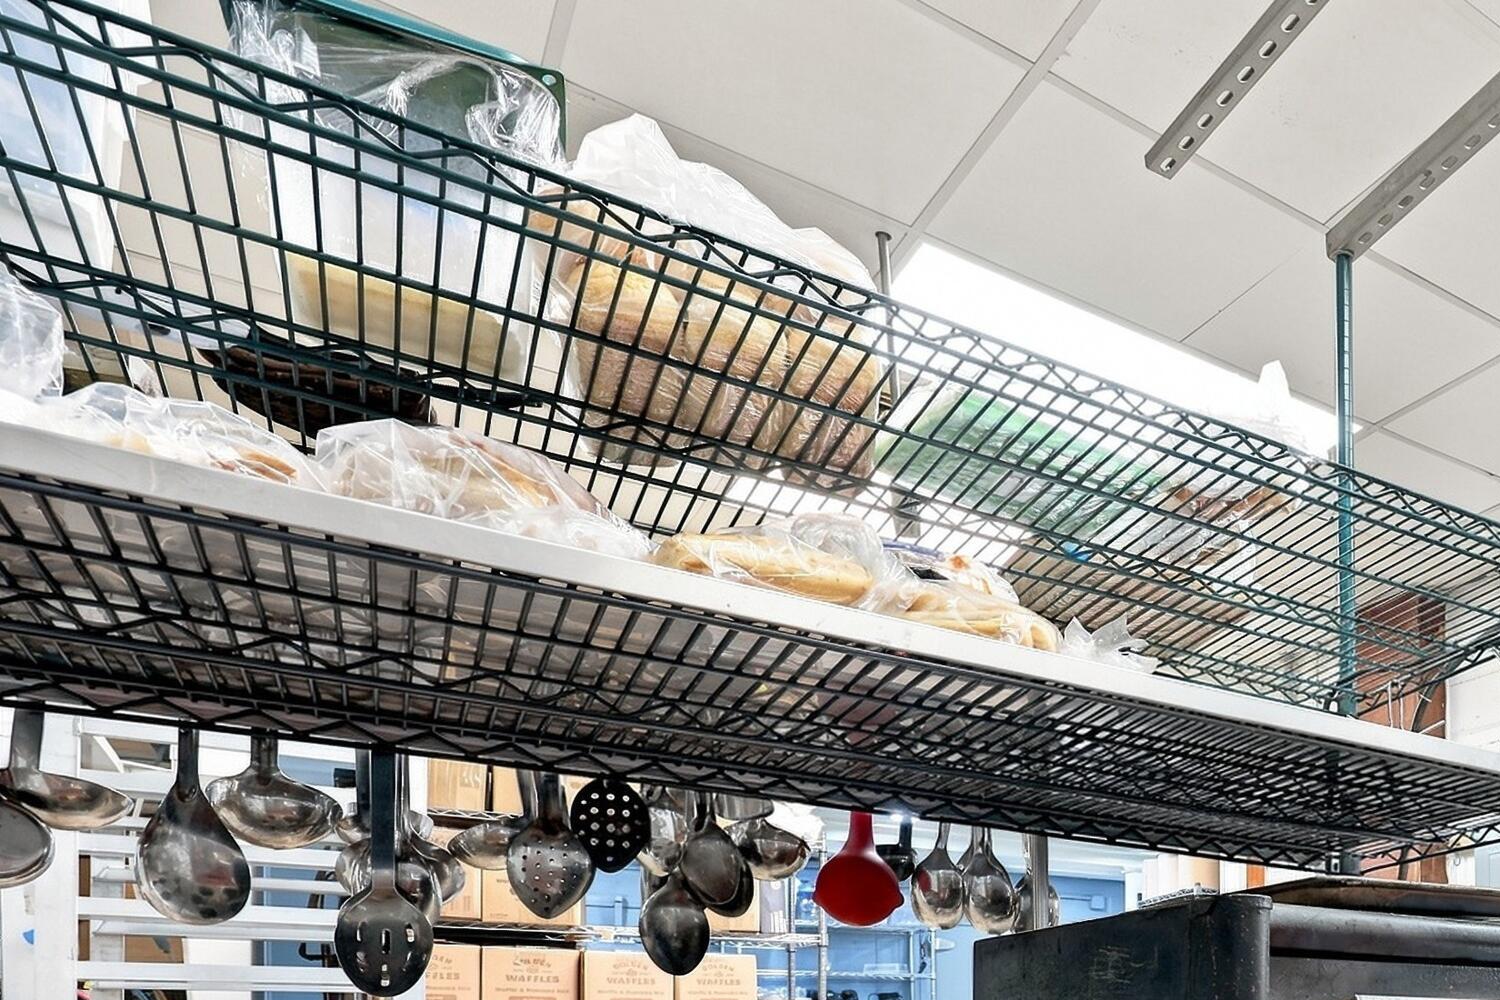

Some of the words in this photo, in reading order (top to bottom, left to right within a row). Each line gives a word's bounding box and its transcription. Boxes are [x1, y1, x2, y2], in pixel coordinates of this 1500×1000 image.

[505, 974, 560, 983] WAFFLES
[606, 976, 656, 985] WAFFLES
[696, 978, 741, 986] WAFFLES
